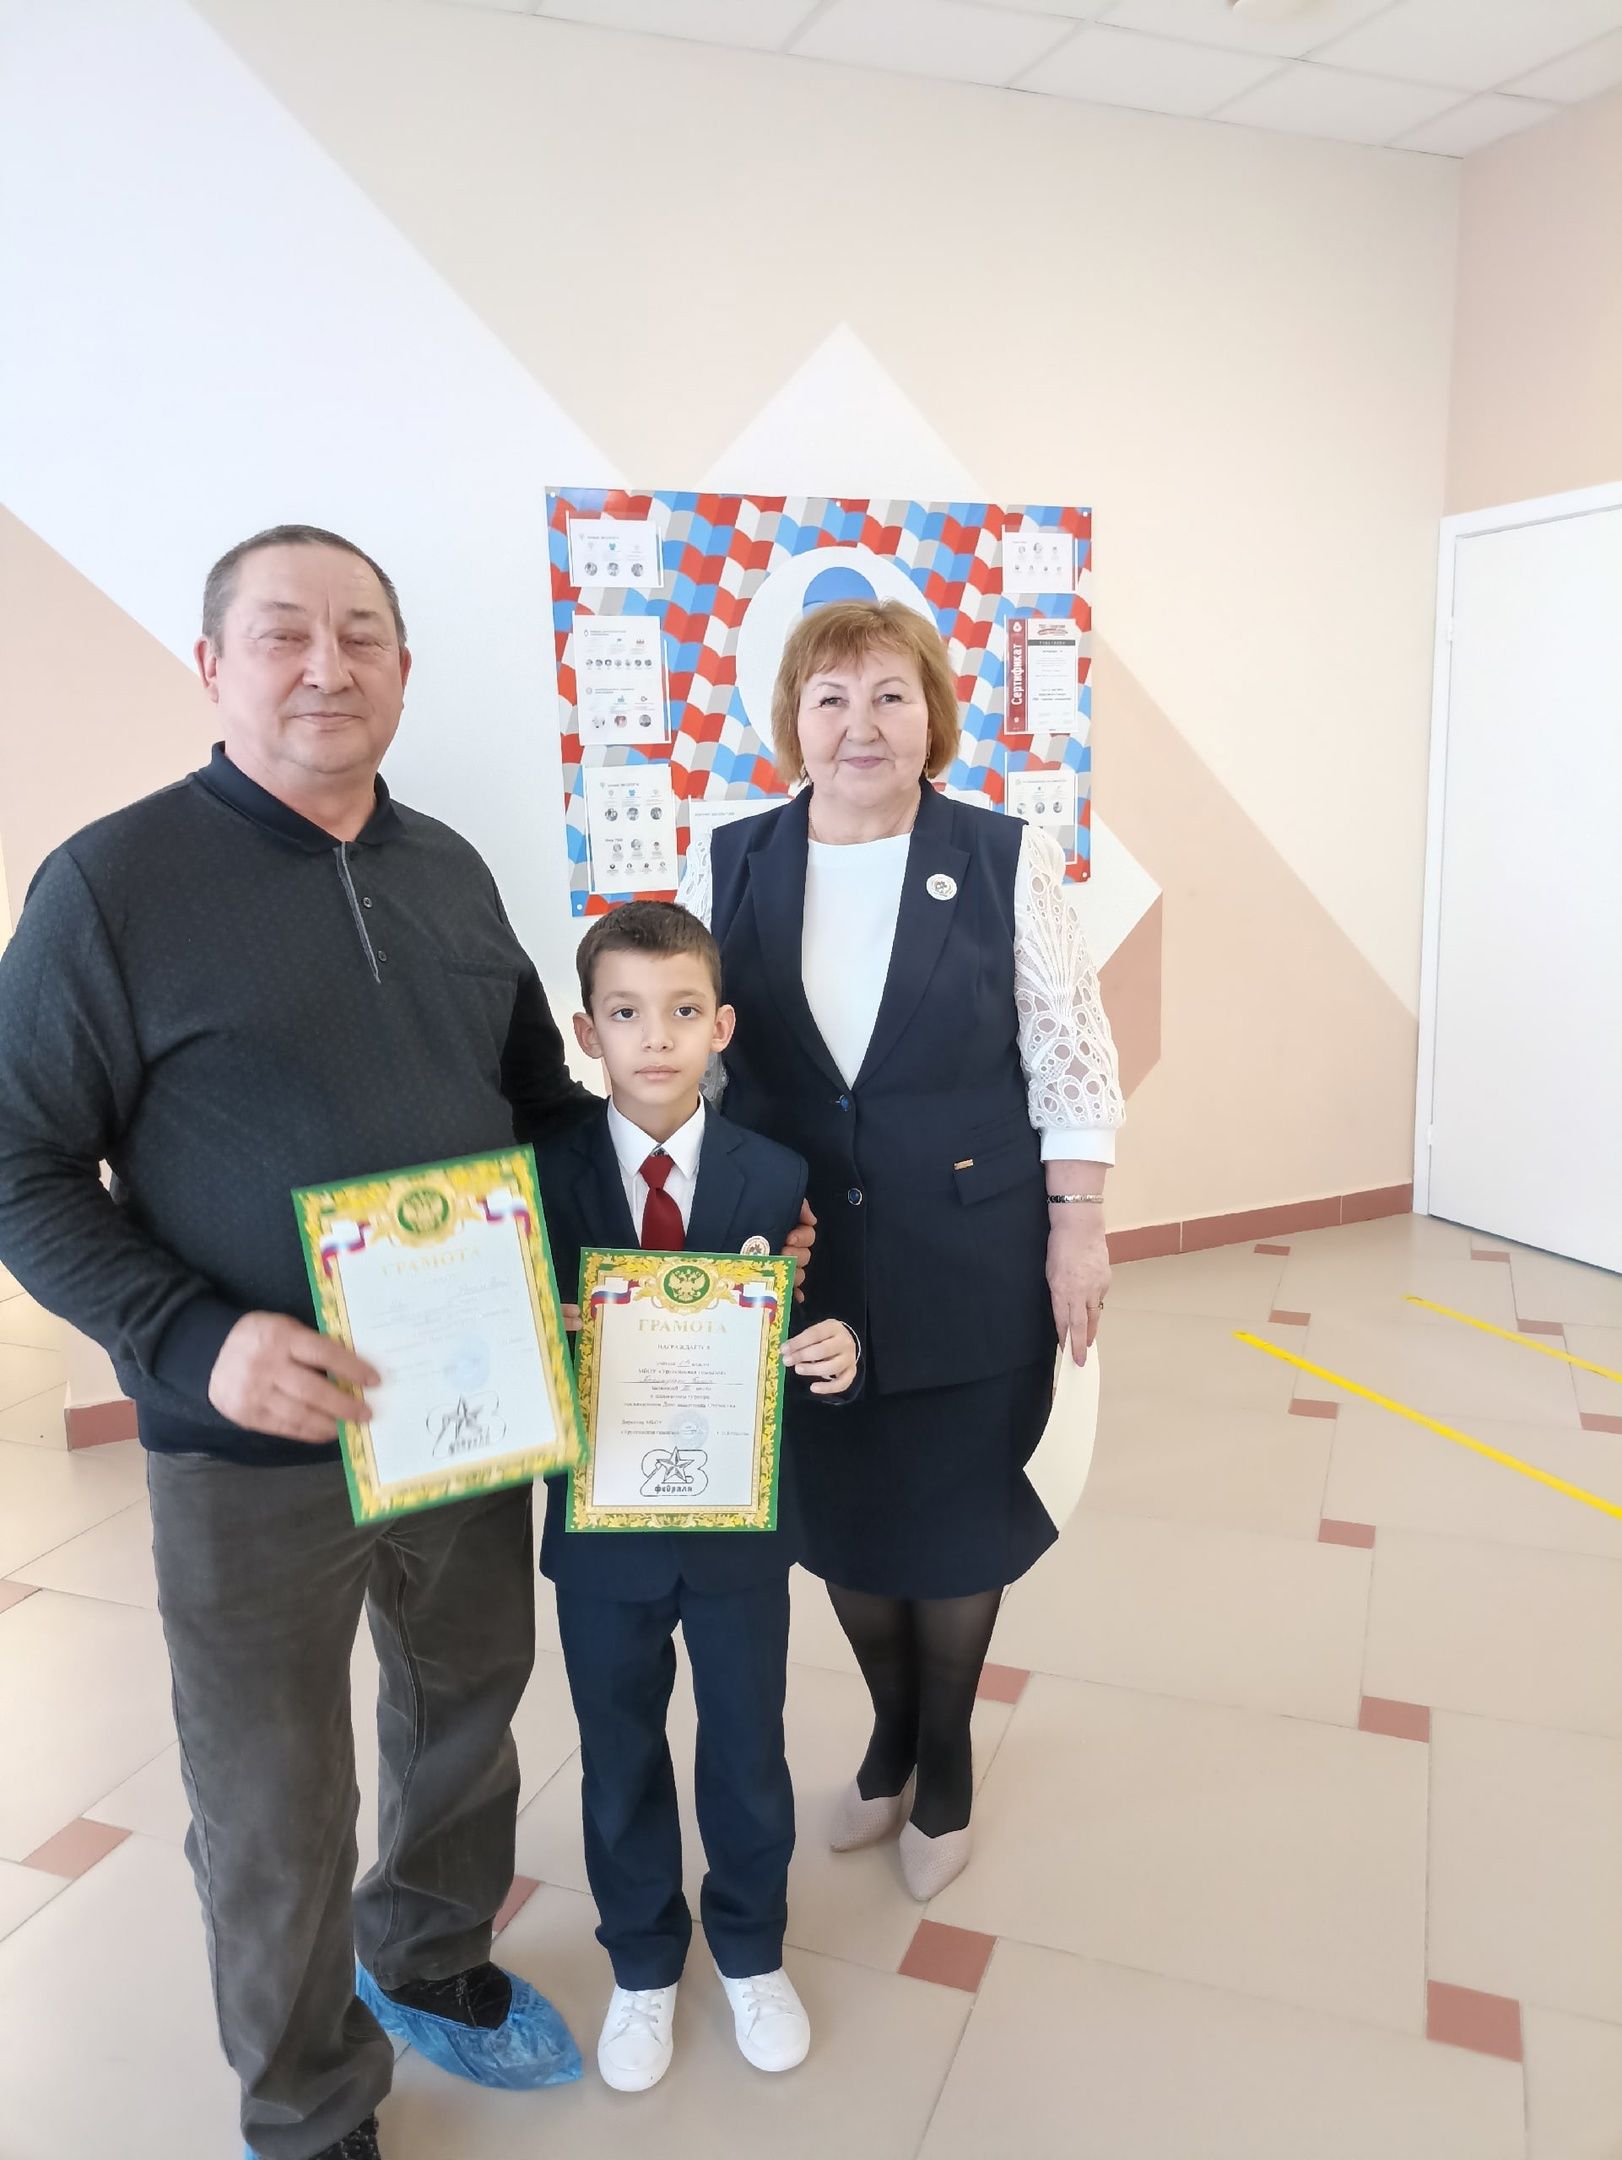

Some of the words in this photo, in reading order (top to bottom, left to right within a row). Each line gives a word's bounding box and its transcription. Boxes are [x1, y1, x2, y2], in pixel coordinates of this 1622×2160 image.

[1011, 644, 1024, 705] Сертификат
[381, 1248, 481, 1276] ГРАМОТА
[637, 1318, 728, 1334] ГРАМОТА
[640, 1448, 709, 1497] 23
[654, 1484, 693, 1494] февраля
